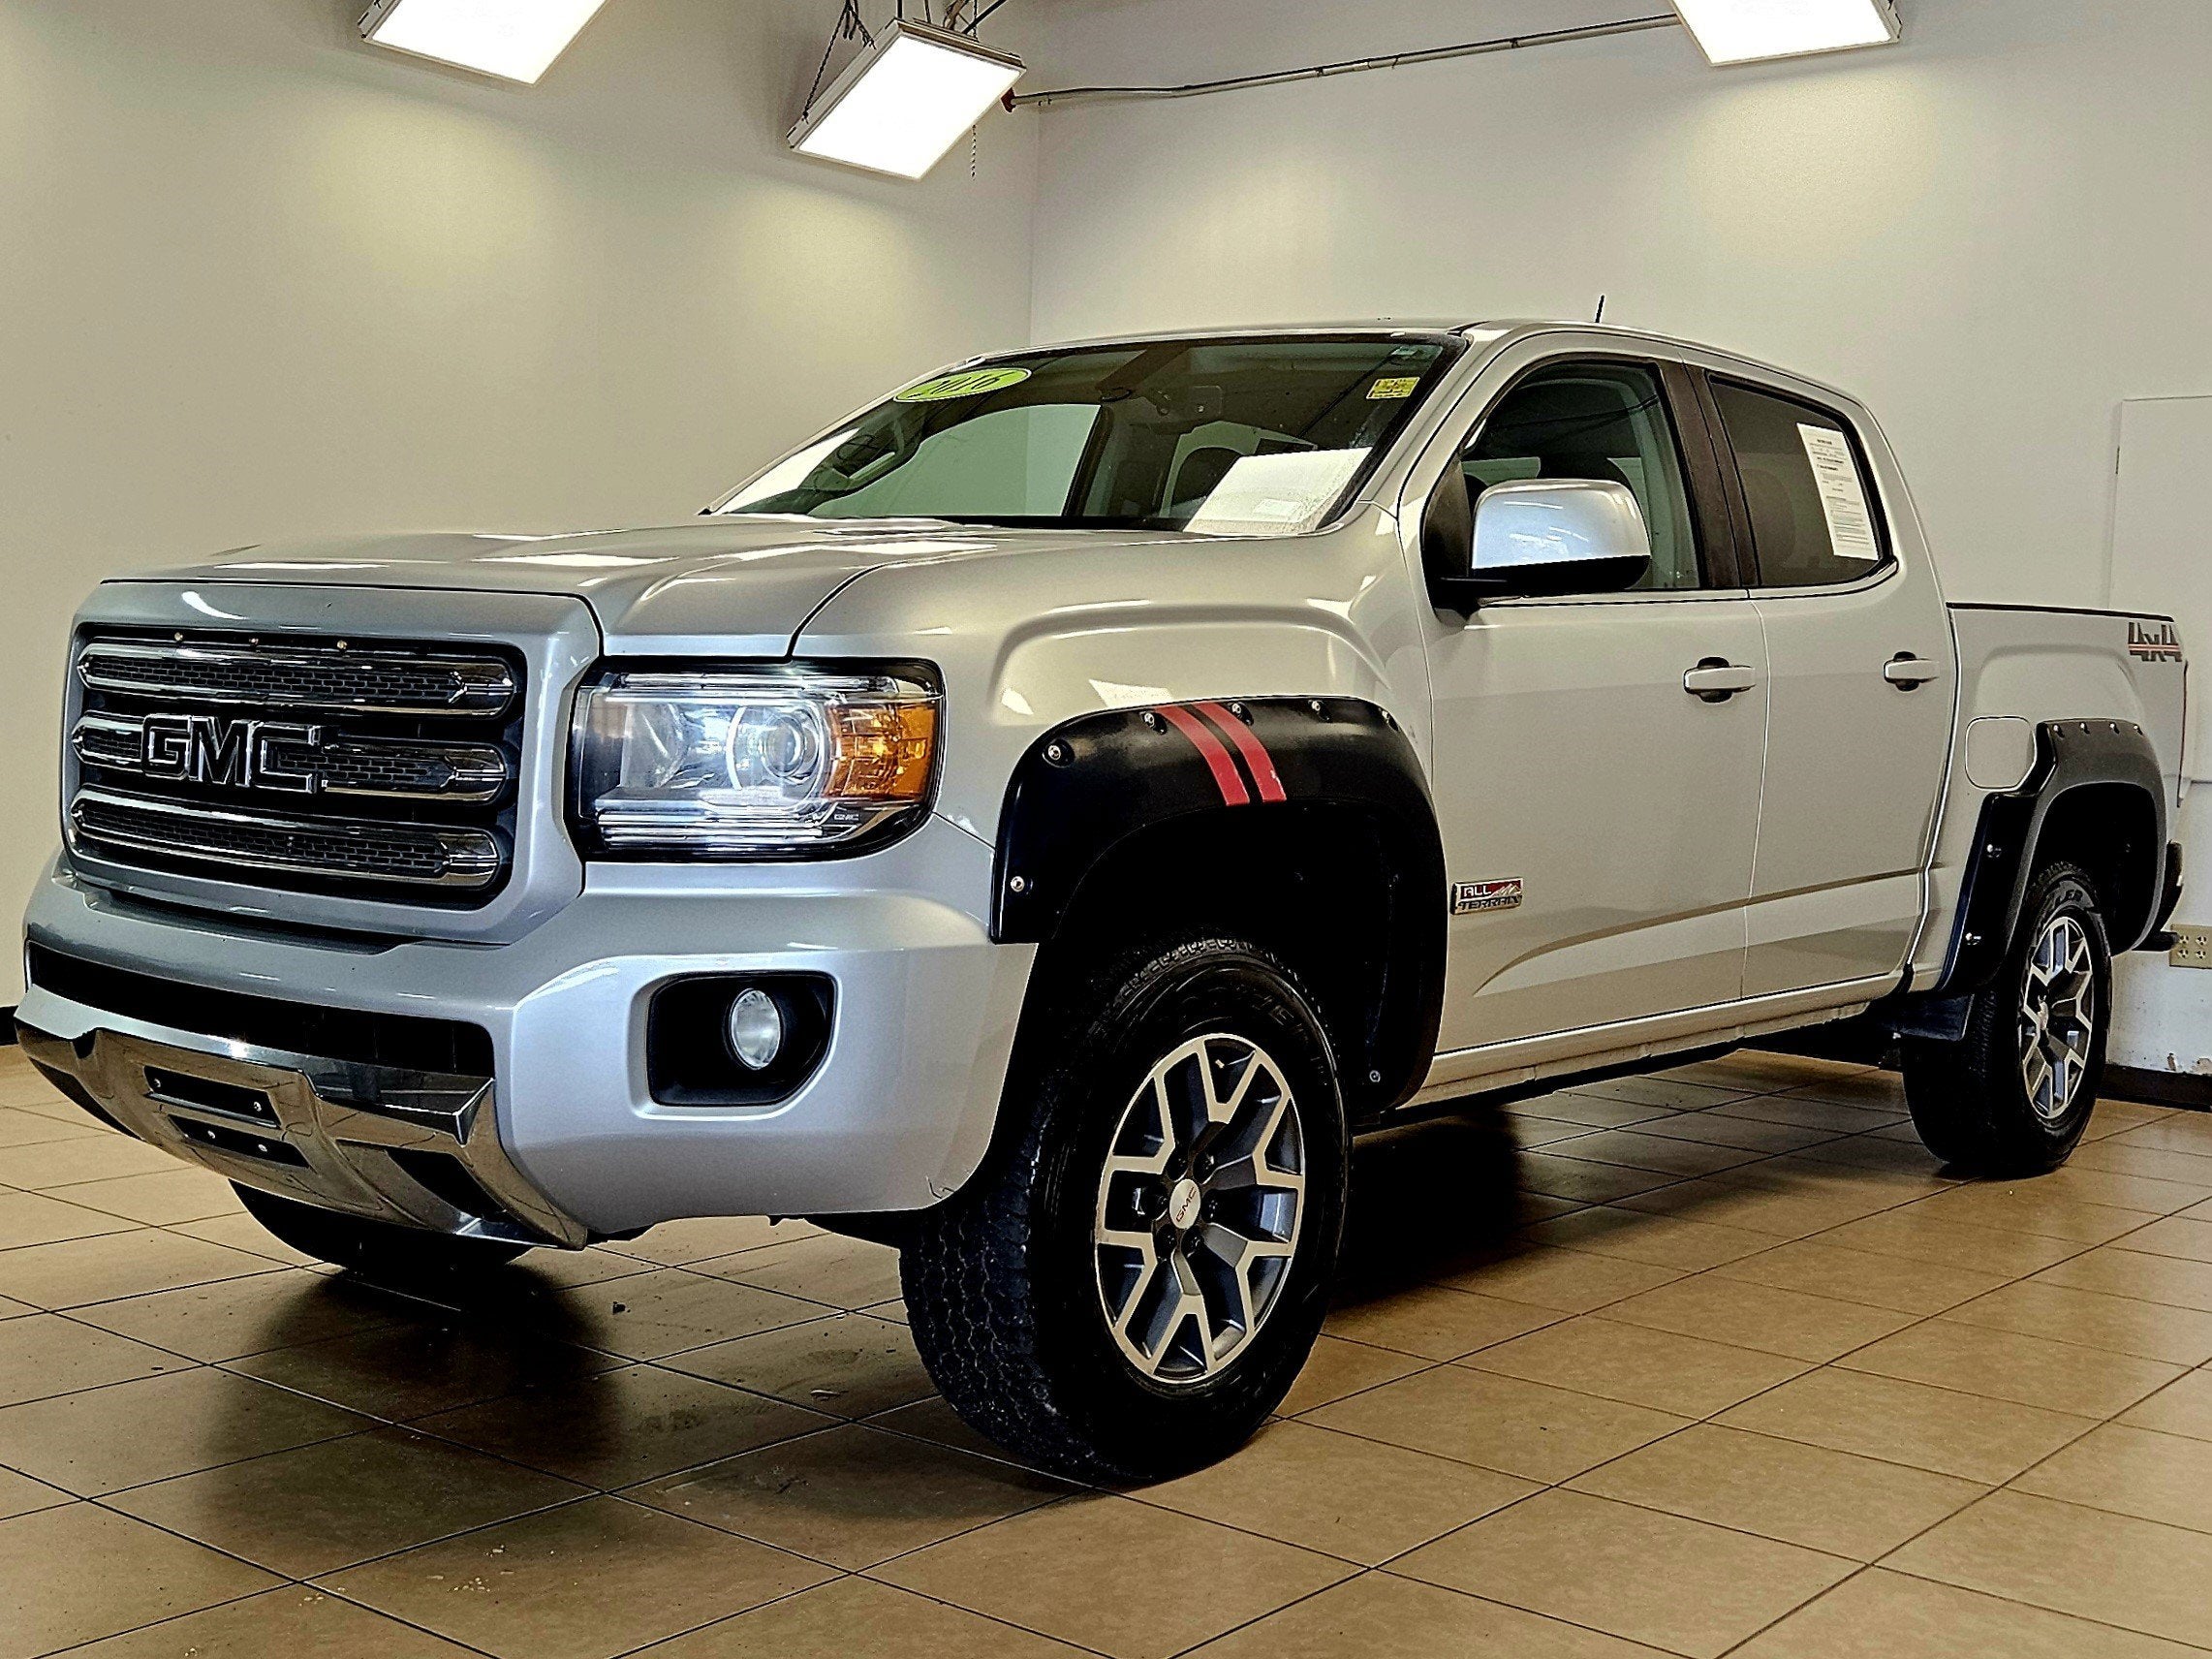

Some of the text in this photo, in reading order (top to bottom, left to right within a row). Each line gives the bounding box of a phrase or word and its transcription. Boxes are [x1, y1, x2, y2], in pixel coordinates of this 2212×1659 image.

[141, 713, 321, 795] GMC
[1463, 885, 1492, 897] ALL
[1175, 1187, 1198, 1223] GMC
